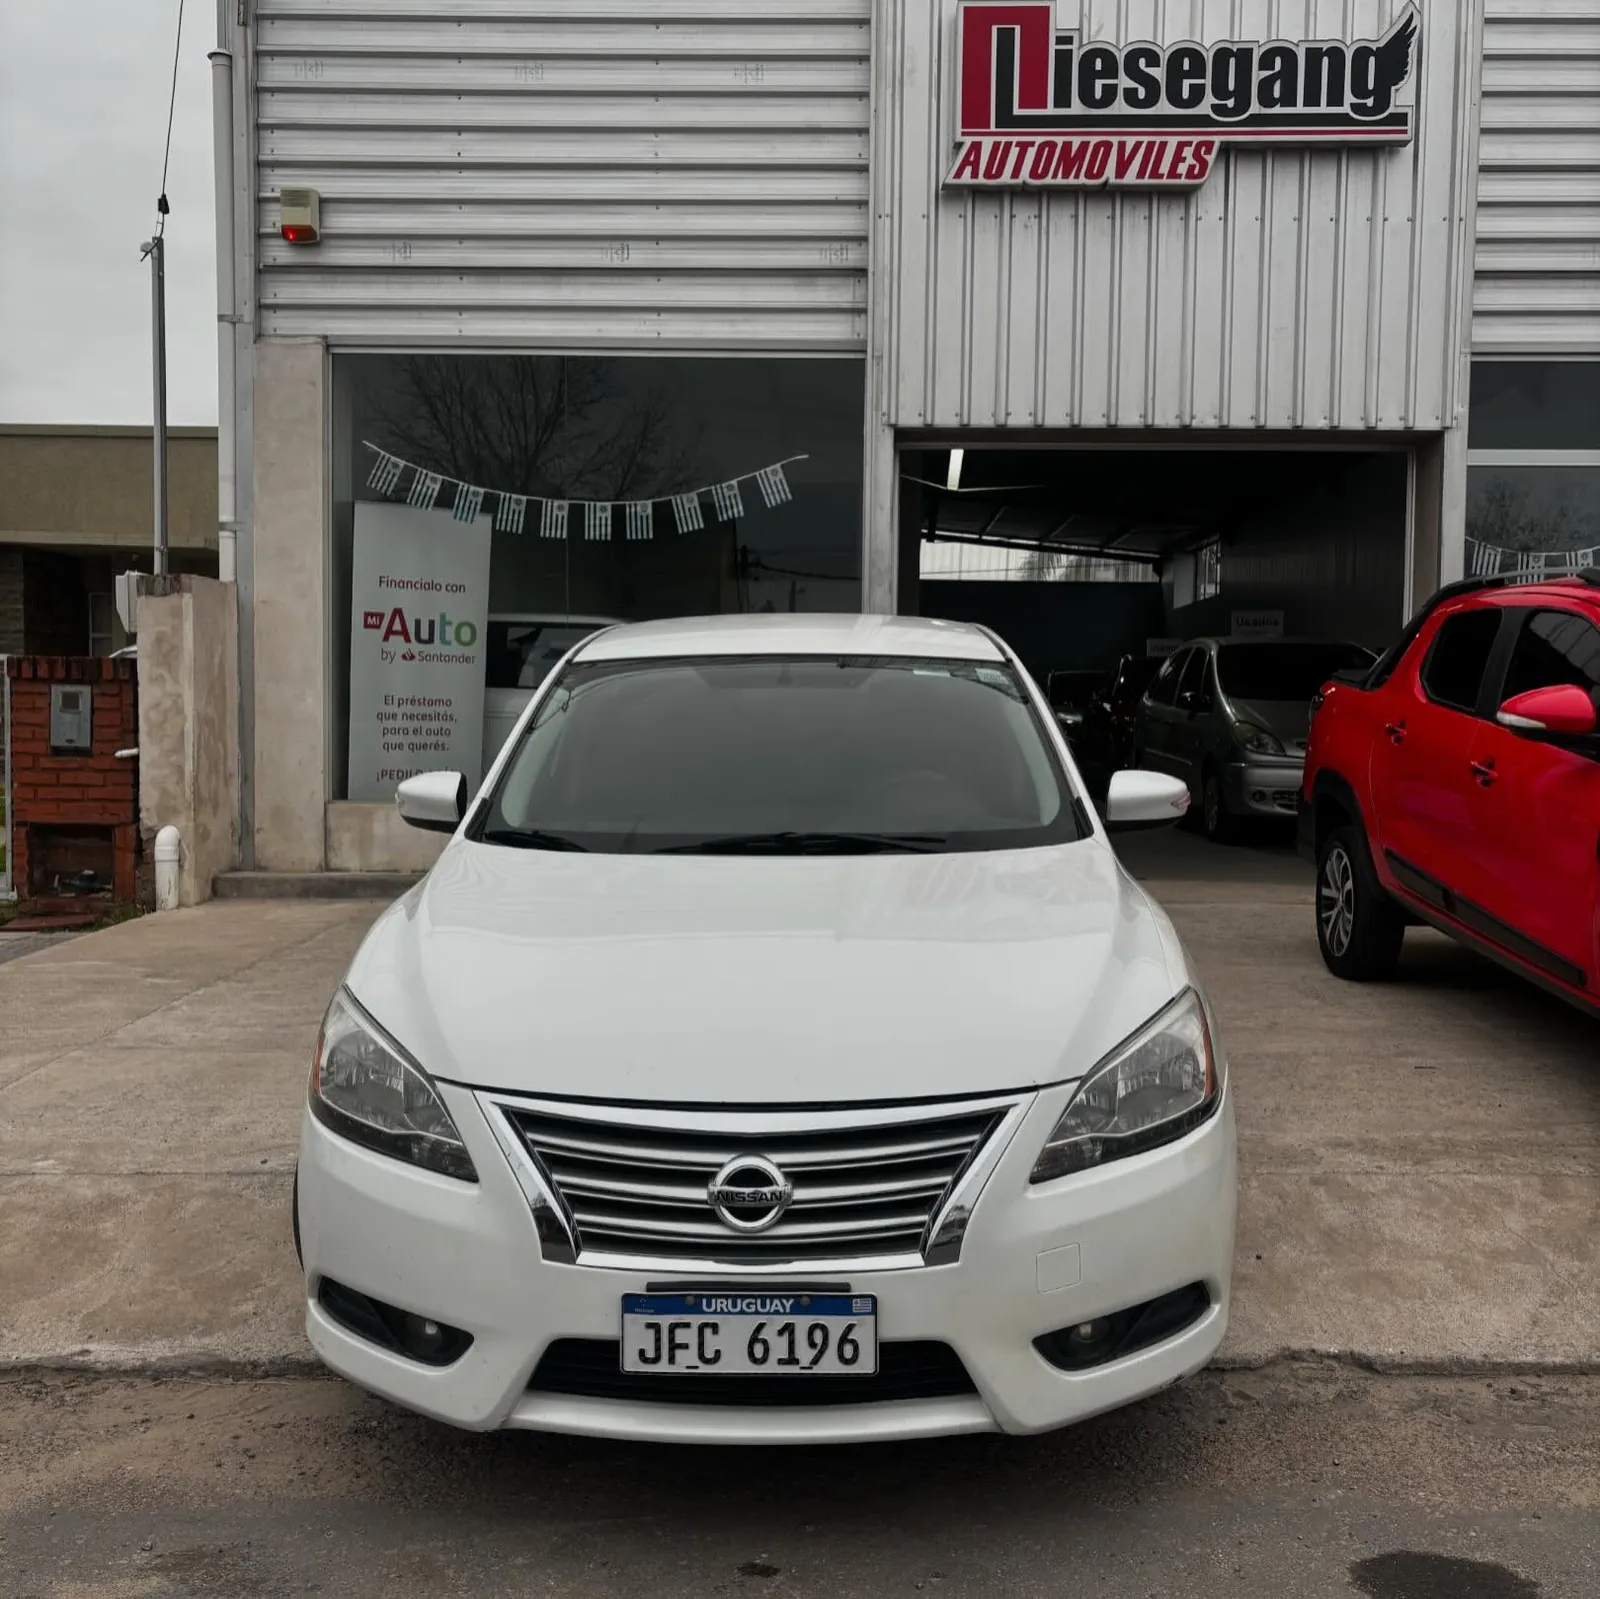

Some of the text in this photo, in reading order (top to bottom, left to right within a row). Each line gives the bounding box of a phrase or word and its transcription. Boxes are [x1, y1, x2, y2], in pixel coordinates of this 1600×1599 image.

[995, 27, 1408, 129] Liesegang
[952, 140, 1215, 182] AUTOMOVILES
[445, 583, 466, 594] con
[367, 607, 477, 647] MI Auto
[381, 648, 476, 665] by Santander
[384, 694, 452, 709] El préstamo
[376, 711, 398, 725] que
[382, 725, 451, 739] para el auto
[382, 741, 404, 754] que
[716, 1189, 783, 1203] NISSAN
[702, 1298, 795, 1314] URUGUAY
[637, 1321, 861, 1367] JFC 6196
